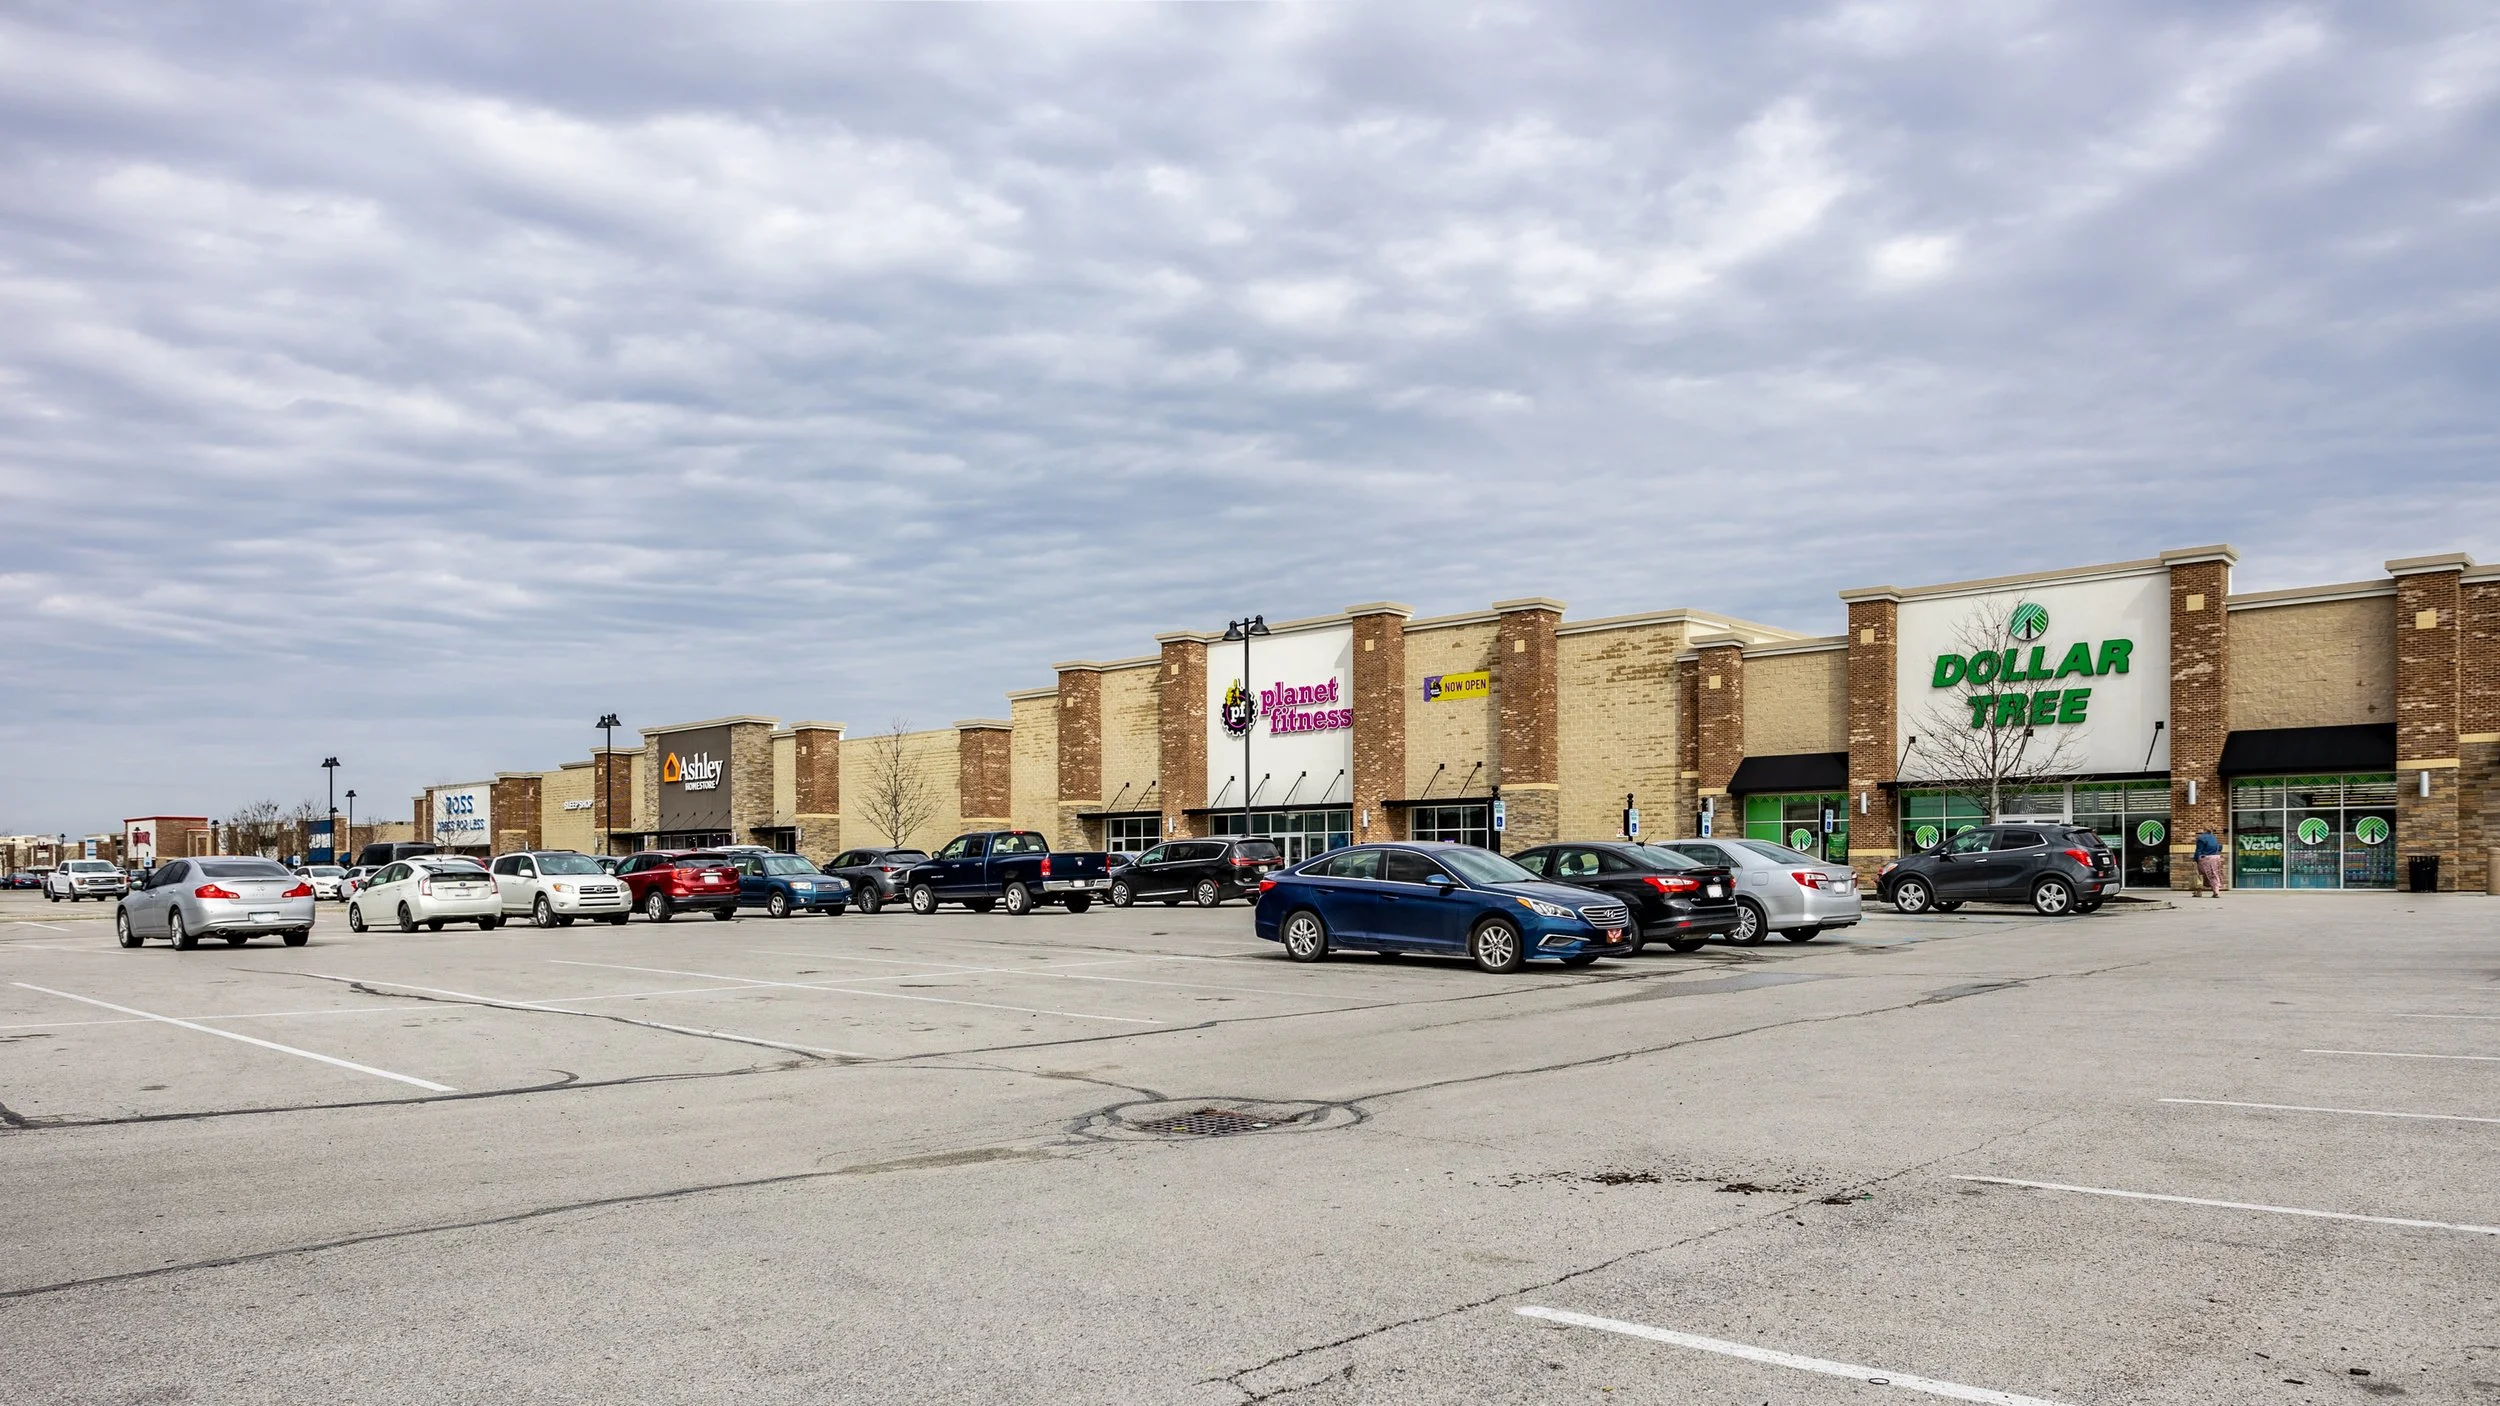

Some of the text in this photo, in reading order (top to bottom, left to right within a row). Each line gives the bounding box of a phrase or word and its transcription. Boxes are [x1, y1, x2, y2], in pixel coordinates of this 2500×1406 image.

[1932, 639, 2134, 688] DOLLAR
[1260, 676, 1339, 715] planet
[1445, 681, 1463, 693] NOW
[1465, 679, 1486, 691] OPEN
[1230, 701, 1246, 723] pf
[1270, 707, 1354, 734] fitness
[1967, 688, 2092, 729] TREE
[678, 752, 724, 785] Ashley
[684, 780, 717, 791] HOMESTORE
[2242, 840, 2283, 850] Value
